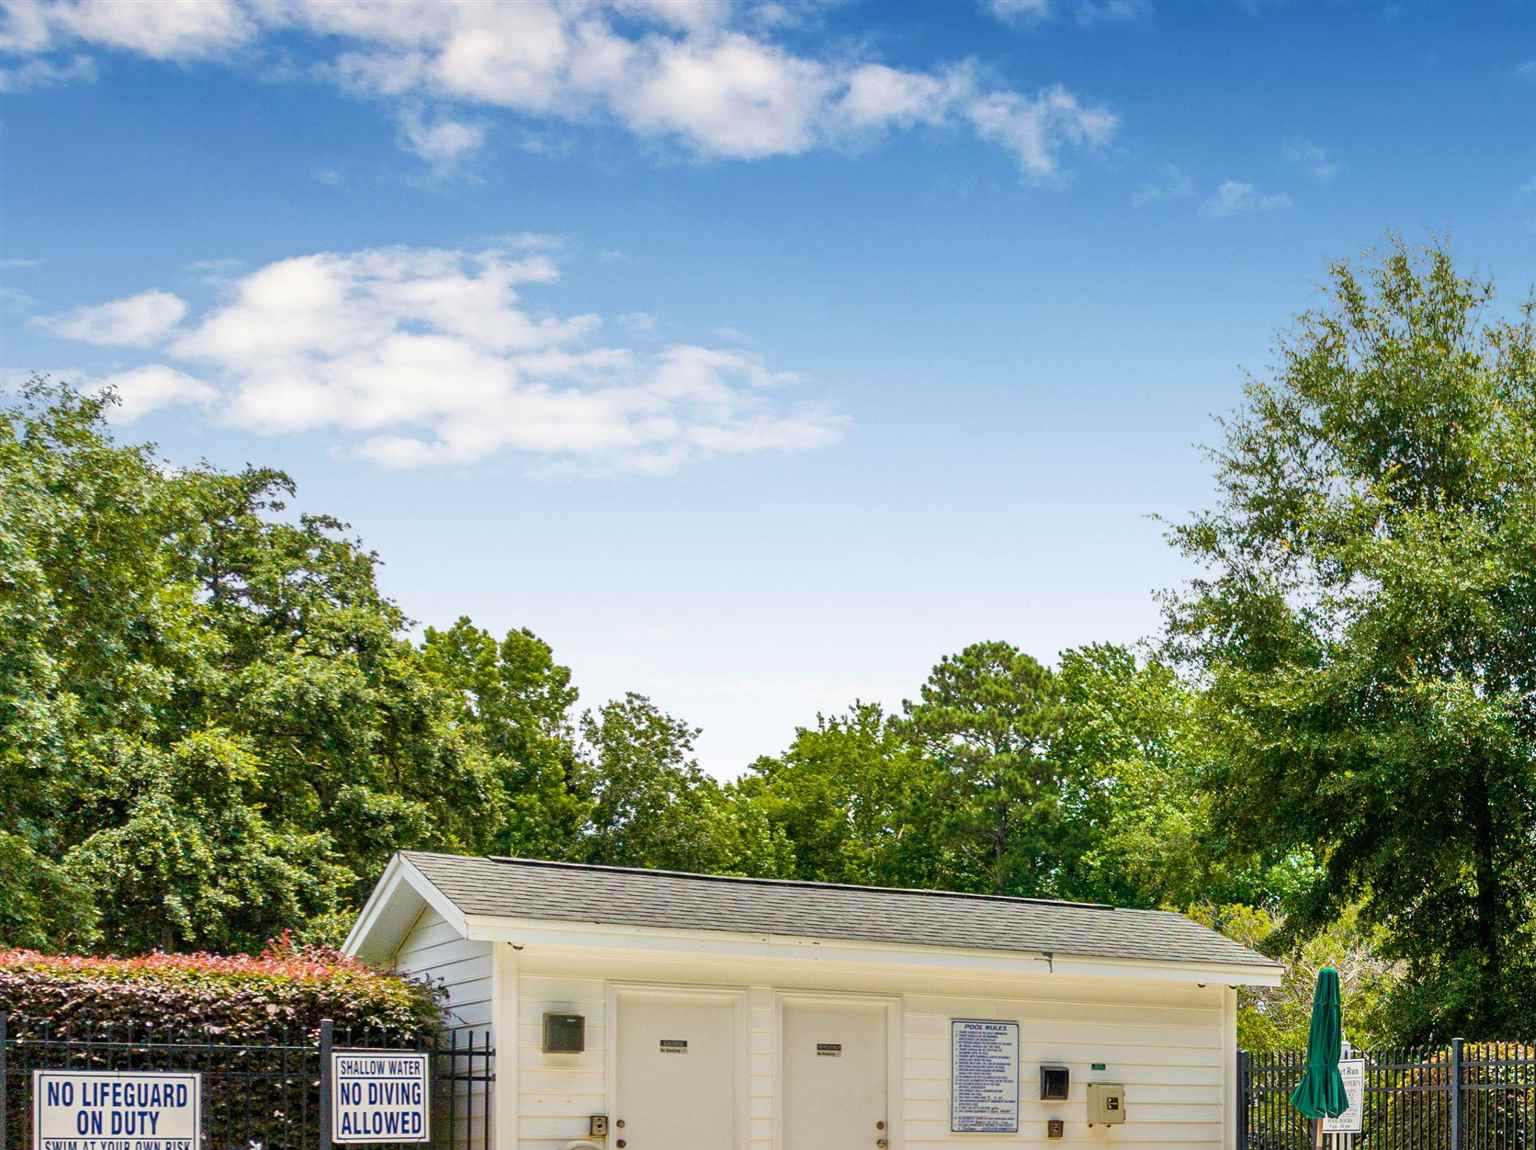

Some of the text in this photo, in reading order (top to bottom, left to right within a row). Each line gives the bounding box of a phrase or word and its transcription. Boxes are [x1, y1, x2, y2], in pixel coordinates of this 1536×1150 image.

[340, 1060, 421, 1075] SHALLOW WATER
[47, 1081, 188, 1108] NO LIFEGUARD
[340, 1082, 421, 1106] NO DIVING
[76, 1110, 160, 1136] ON DUTY
[341, 1111, 422, 1135] ALLOWED
